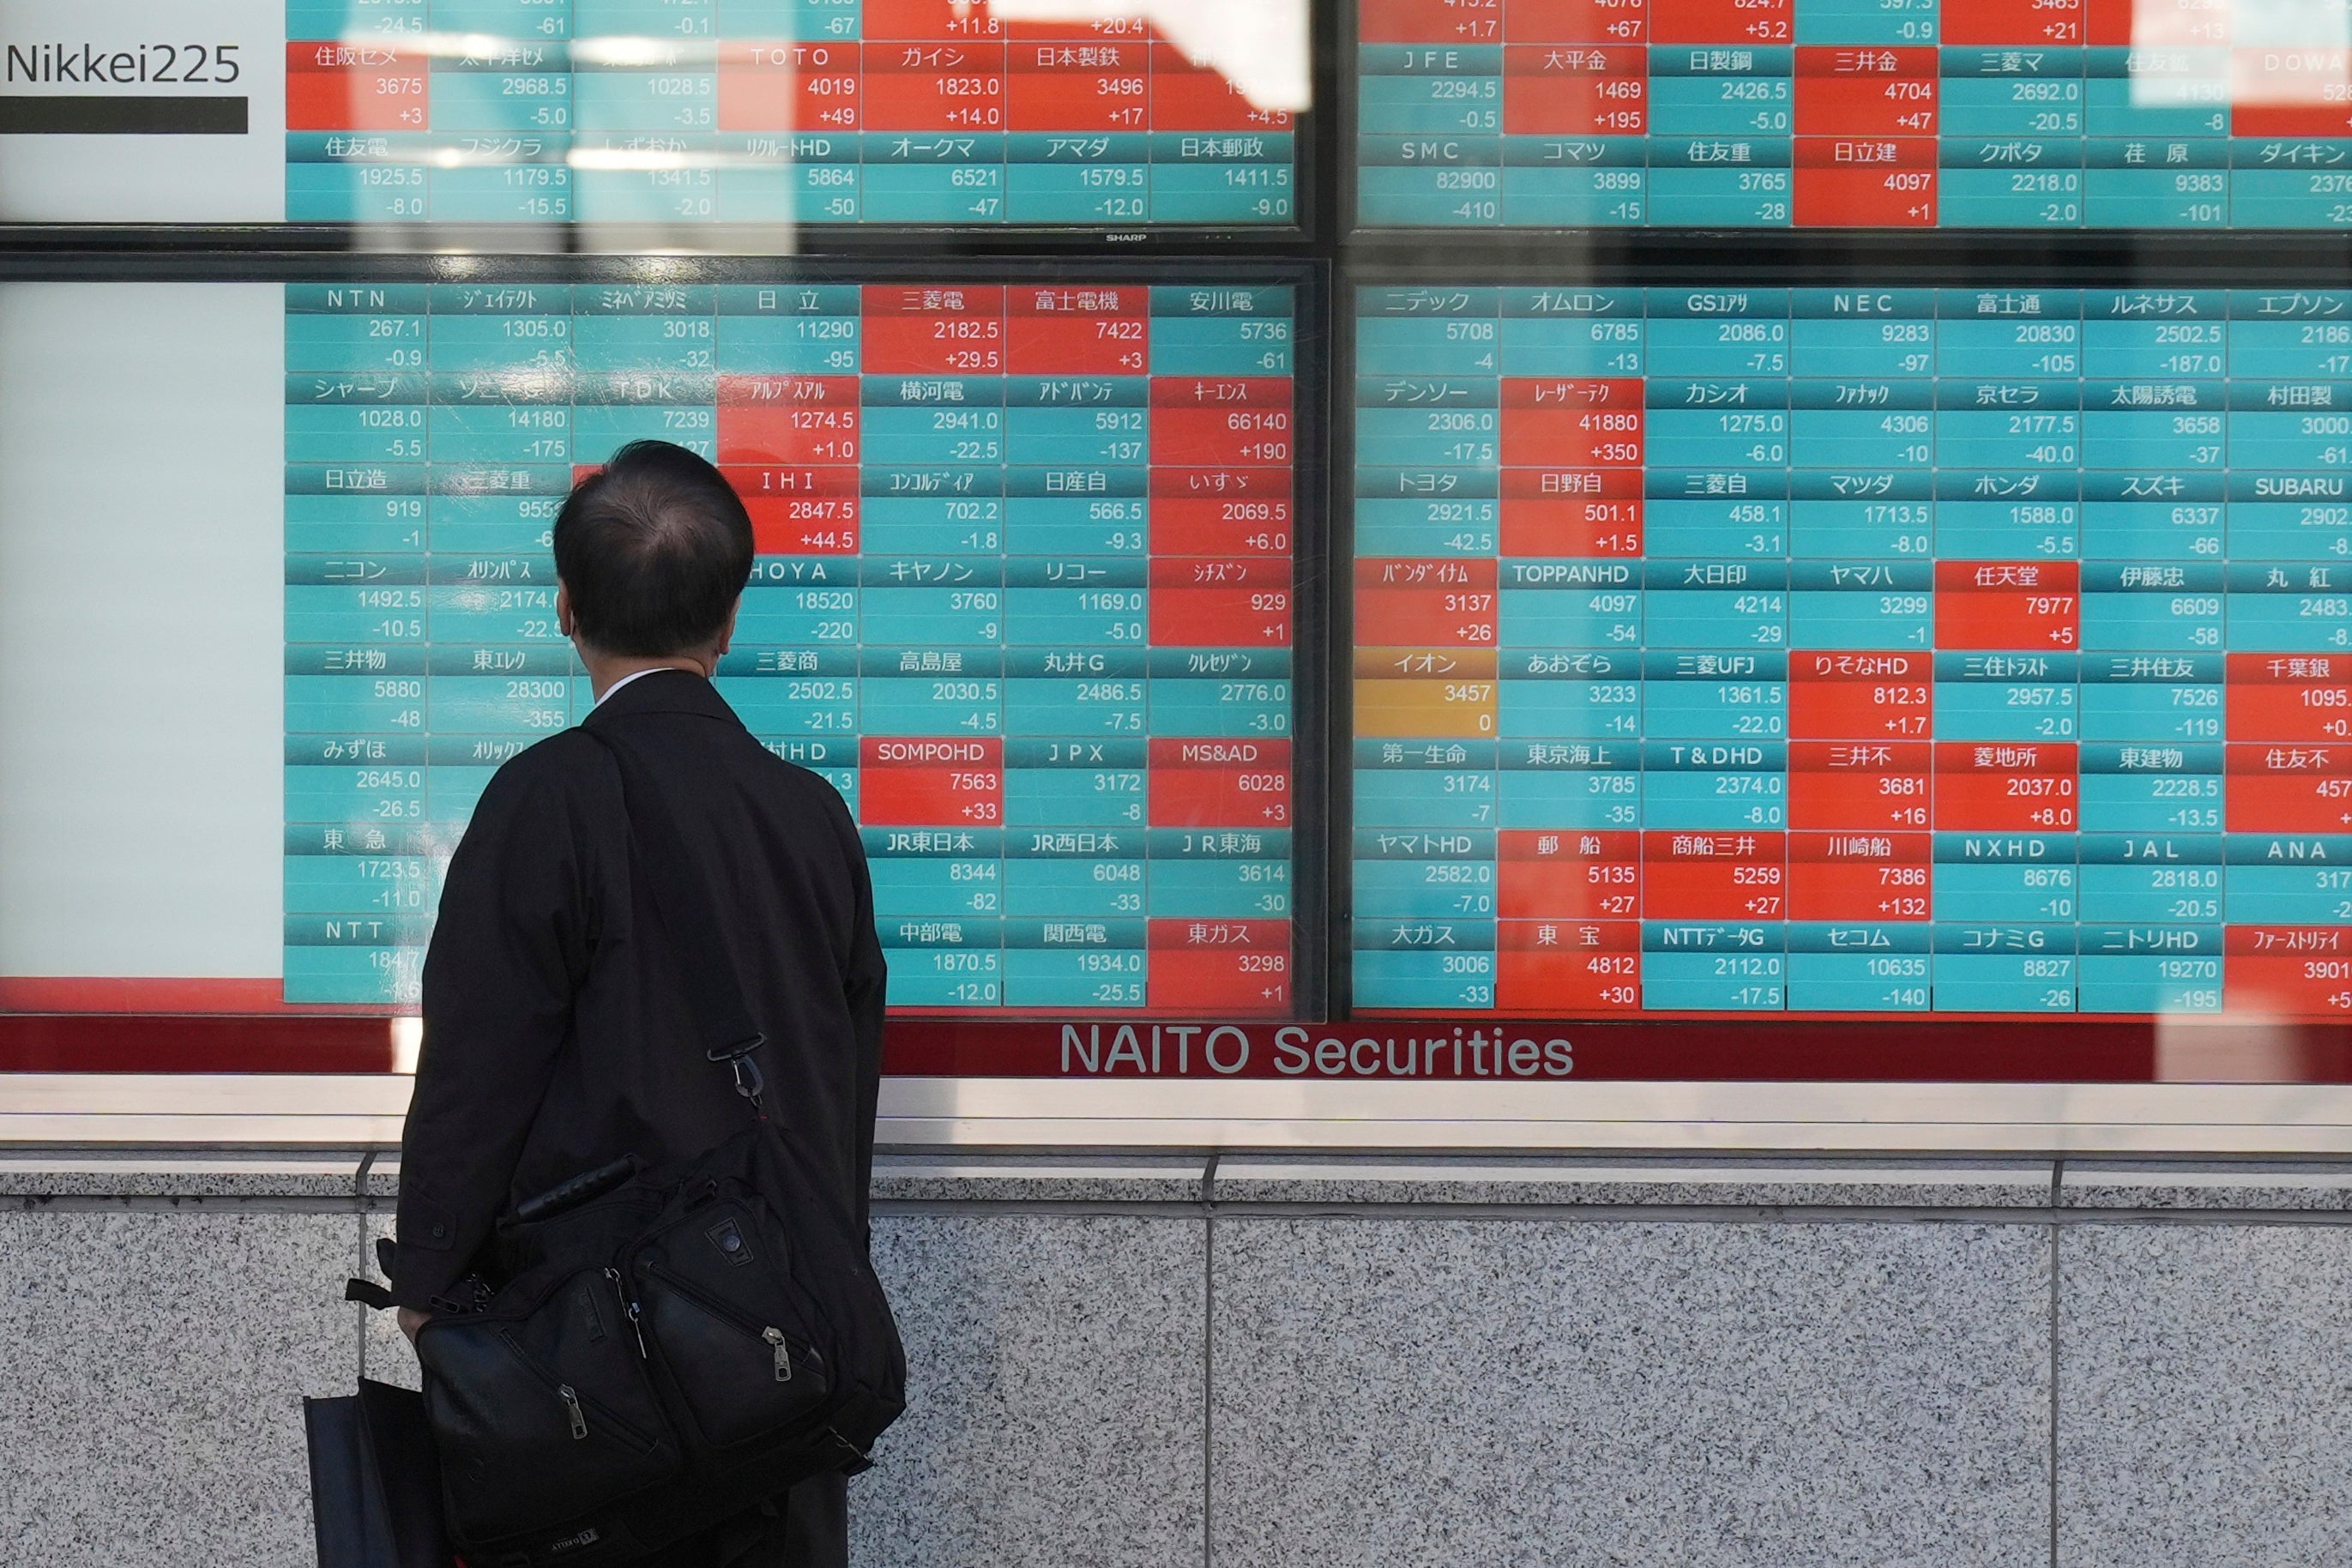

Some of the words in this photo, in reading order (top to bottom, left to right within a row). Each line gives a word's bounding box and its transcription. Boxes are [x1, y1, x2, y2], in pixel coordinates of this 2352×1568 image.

[946, 18, 999, 33] +11.8
[1746, 21, 1787, 37] +5.2
[2042, 24, 2077, 39] +21
[6, 43, 241, 83] Nikkei225
[316, 47, 396, 67] 住阪セメ
[902, 47, 964, 67] ガイシ
[1037, 46, 1120, 67] 日本製鉄
[1543, 49, 1607, 70] 大平金
[1690, 50, 1752, 71] 日製鋼
[1834, 51, 1898, 72] 三井金
[1980, 51, 2044, 72] 三菱マ
[936, 78, 999, 95] 1823.0
[1097, 77, 1143, 95] 3496
[1432, 81, 1496, 99] 2294.5
[1721, 81, 1788, 100] 2426.5
[2012, 82, 2078, 101] 2692.0
[946, 107, 999, 125] +14.0
[1594, 111, 1641, 129] +195
[1897, 112, 1933, 130] +47
[325, 138, 388, 158] 住友電
[891, 137, 975, 158] オークマ
[1046, 136, 1110, 158] アマダ
[1181, 136, 1263, 158] 日本郵政
[1543, 142, 1606, 162] コマツ
[1687, 141, 1752, 162] 住友重
[1835, 142, 1897, 162] 日立建
[1979, 142, 2042, 163] クボタ
[2259, 142, 2345, 164] ダイキン
[951, 168, 997, 186] 6521
[1225, 168, 1288, 186] 1411.5
[1436, 171, 1496, 190] 82900
[1883, 172, 1932, 191] 4097
[2174, 173, 2224, 193] 9383
[1095, 198, 1143, 216] -12.0
[2179, 203, 2222, 222] -101
[902, 290, 965, 311] 三菱電
[1034, 289, 1119, 311] 富士電機
[1190, 291, 1254, 311] 安川電
[1385, 290, 1469, 311] ニデック
[1530, 293, 1614, 311] オムロン
[1976, 292, 2041, 314] 富士通
[2111, 293, 2198, 315] ルネサス
[2258, 292, 2343, 315] エプソン
[369, 319, 419, 337] 267.1
[503, 319, 566, 338] 1305.0
[663, 320, 710, 338] 3018
[933, 321, 998, 339] 2182.5
[1240, 322, 1287, 341] 5736
[1446, 322, 1494, 341] 5708
[1718, 323, 1784, 342] 2086.0
[2015, 325, 2076, 343] 20830
[2155, 324, 2222, 344] 2502.5
[945, 351, 998, 368] +29.5
[315, 379, 395, 399] シャープ
[900, 380, 965, 401] 横河電
[1384, 380, 1468, 402] デンソー
[1686, 383, 1749, 404] カシオ
[1975, 384, 2039, 405] 京セラ
[2111, 384, 2198, 406] 太陽誘電
[2267, 385, 2332, 406] 村田製
[359, 409, 422, 428] 1028.0
[1227, 413, 1287, 431] 66140
[1578, 413, 1637, 431] 41880
[1880, 415, 1929, 433] 4306
[385, 438, 422, 457] -5.5
[523, 439, 565, 457] -175
[1590, 443, 1637, 461] +350
[326, 468, 392, 491] 日立造
[1046, 470, 1107, 492] 日産自
[1190, 472, 1246, 492] いすゞ
[1400, 472, 1458, 492] トヨタ
[1541, 472, 1601, 493] 日野自
[1685, 473, 1746, 494] 三菱自
[1830, 473, 1894, 495] マツダ
[1975, 474, 2040, 496] ホンダ
[2121, 474, 2186, 496] スズキ
[2255, 478, 2343, 496] SUBARU
[385, 499, 422, 518] 919
[789, 501, 854, 519] 2847.5
[945, 502, 998, 520] 702.2
[1728, 504, 1780, 522] 458.1
[2171, 507, 2220, 525] 6337
[1245, 533, 1287, 550] +6.0
[324, 559, 386, 579] ニコン
[890, 561, 974, 582] キヤノン
[1046, 562, 1107, 581] リコー
[1512, 564, 1629, 583] TOPPANHD
[1684, 564, 1746, 584] 大日印
[1830, 564, 1893, 585] ヤマハ
[1974, 565, 2039, 587] 任天堂
[2120, 566, 2185, 588] 伊藤忠
[1078, 593, 1143, 611] 1169.0
[1444, 594, 1492, 612] 3137
[2026, 596, 2073, 614] 7977
[324, 648, 387, 670] 三井物
[756, 650, 819, 672] 三菱商
[900, 650, 962, 672] 高島屋
[1044, 652, 1104, 672] 丸井G
[1394, 653, 1456, 673] イオン
[1527, 653, 1612, 674] あおぞら
[1675, 654, 1755, 675] 三菱UFJ
[1816, 655, 1909, 676] りそなHD
[2109, 656, 2194, 678] 三井住友
[2266, 657, 2331, 678] 千葉銀
[374, 680, 421, 699] 5880
[506, 680, 565, 699] 28300
[1221, 684, 1286, 702] 2776.0
[1444, 684, 1492, 702] 3457
[1873, 686, 1927, 705] 812.3
[1104, 713, 1142, 731] -7.5
[2174, 718, 2219, 737] -119
[324, 739, 387, 758] みずほ
[877, 743, 985, 761] SOMPOHD
[1182, 745, 1257, 762] MS&AD
[1382, 743, 1467, 764] 第一生命
[1527, 743, 1612, 765] 東京海上
[1829, 745, 1891, 766] 三井不
[1974, 746, 2037, 768] 菱地所
[2119, 747, 2183, 769] 東建物
[2265, 748, 2329, 769] 住友不
[356, 769, 421, 789] 2645.0
[950, 773, 998, 791] 7563
[1716, 776, 1782, 795] 2374.0
[2151, 779, 2219, 798] 2228.5
[961, 802, 997, 820] +33
[887, 830, 974, 853] JR東日本
[1030, 833, 1119, 853] JR西日本
[1377, 834, 1472, 854] ヤマトHD
[1673, 835, 1756, 856] 商船三井
[1827, 836, 1892, 857] 川崎船
[1093, 864, 1141, 882] 6048
[1588, 865, 1635, 884] 5135
[2023, 869, 2072, 887] 8676
[1878, 897, 1926, 915] +132
[900, 922, 963, 943] 中部電
[1043, 923, 1107, 944] 関西電
[1187, 922, 1251, 944] 東ガス
[1391, 924, 1456, 944] 大ガス
[1827, 927, 1891, 947] セコム
[1963, 928, 2044, 949] コナミG
[2102, 929, 2199, 949] ニトリHD
[1238, 955, 1285, 972] 3298
[1443, 956, 1490, 974] 3006
[1867, 958, 1926, 977] 10635
[2158, 960, 2217, 979] 19270
[1092, 984, 1141, 1002] -25.5
[1730, 987, 1780, 1005] -17.5
[1061, 1024, 1248, 1075] NAITO
[1272, 1026, 1575, 1078] Securities
